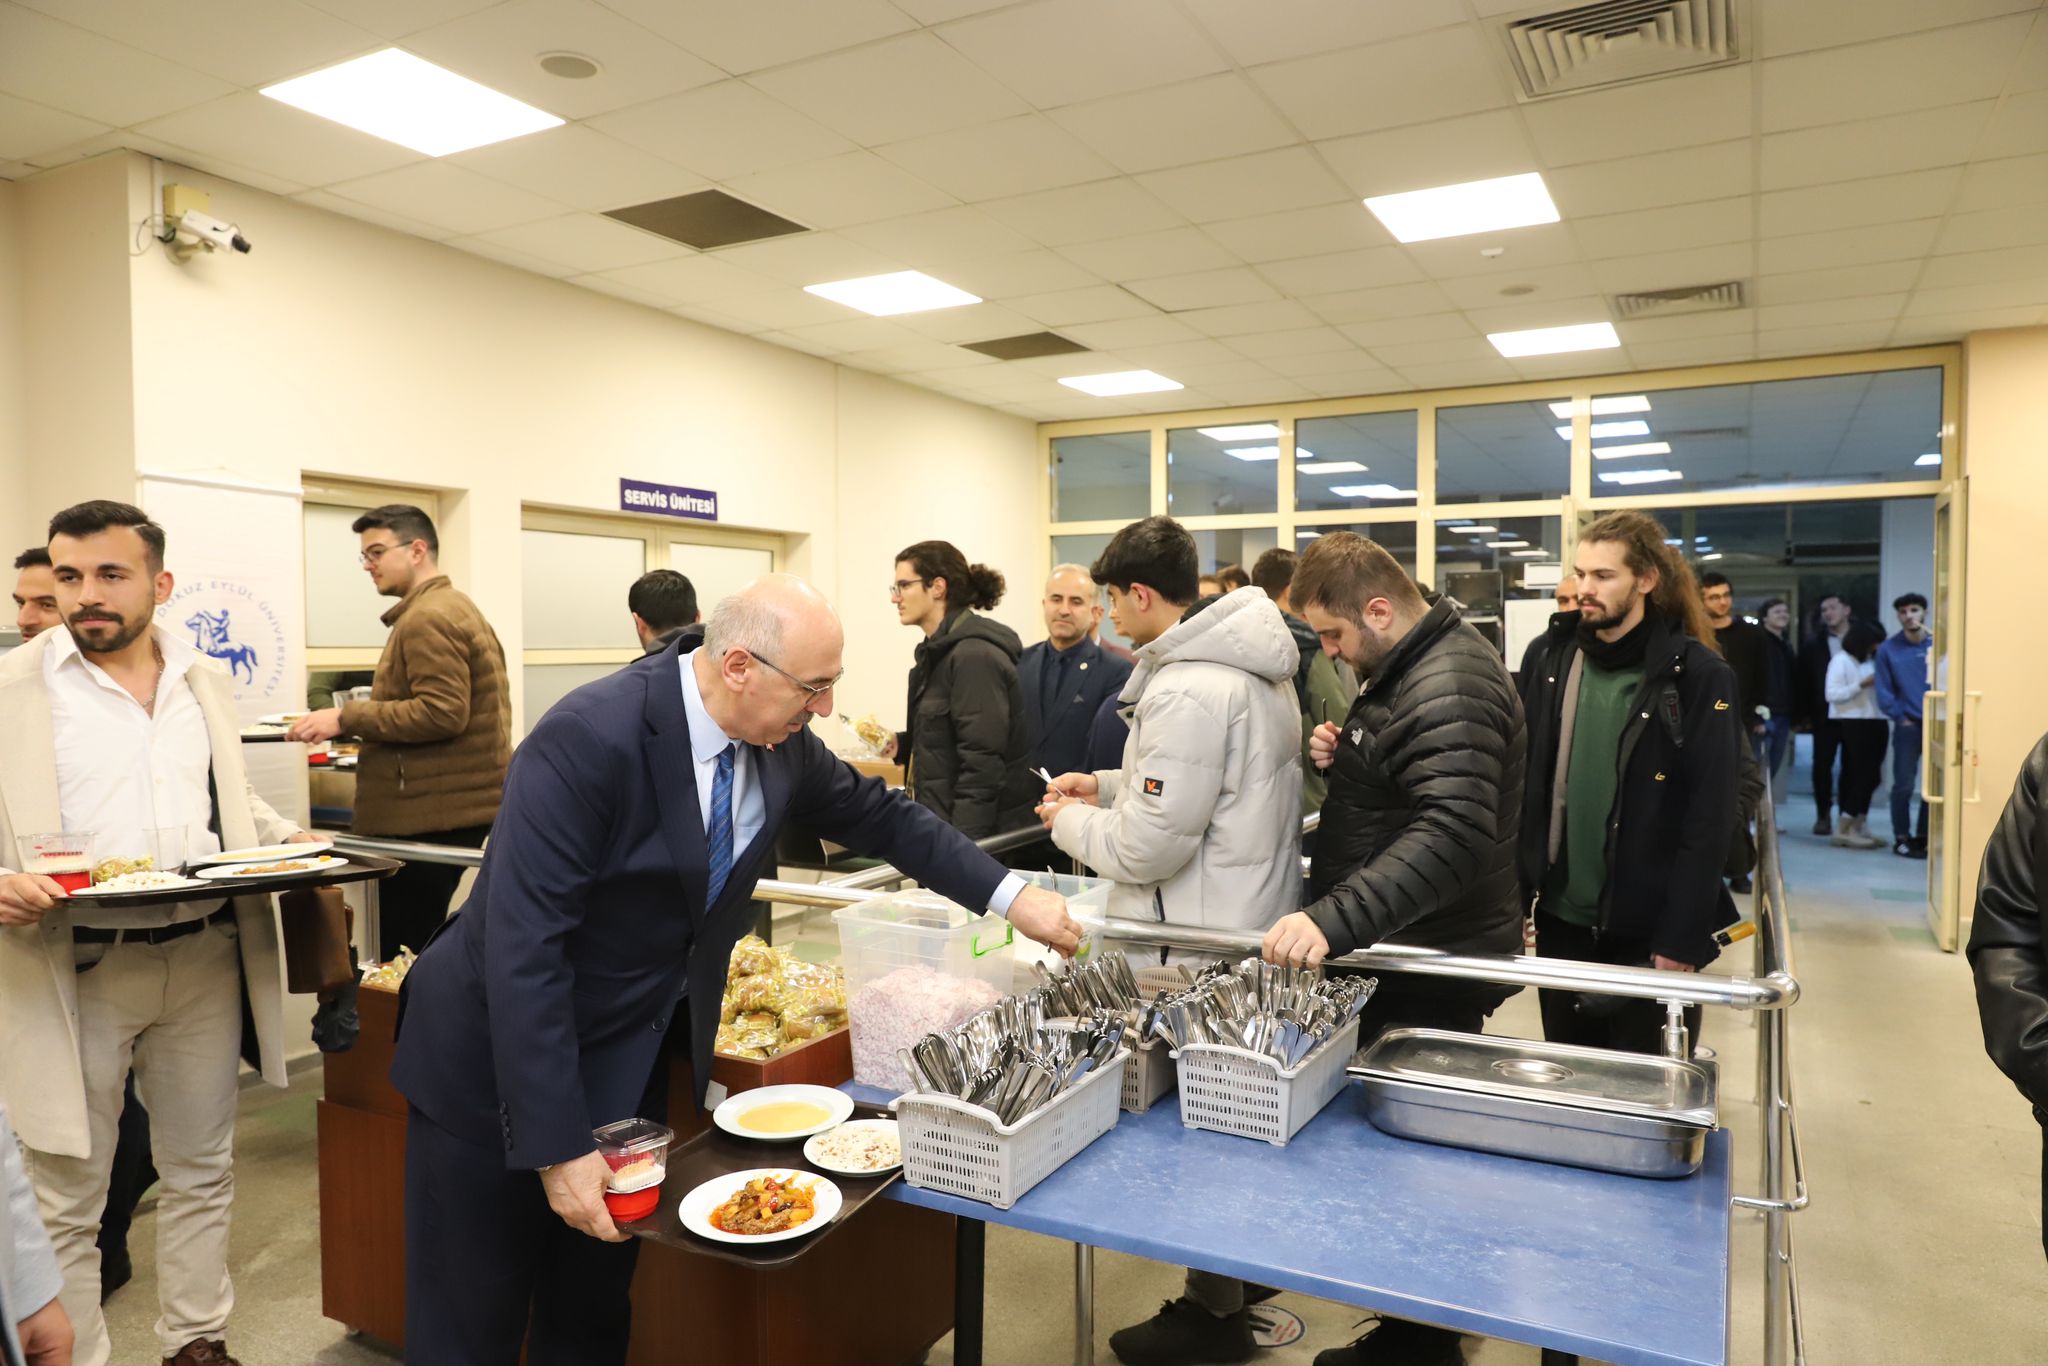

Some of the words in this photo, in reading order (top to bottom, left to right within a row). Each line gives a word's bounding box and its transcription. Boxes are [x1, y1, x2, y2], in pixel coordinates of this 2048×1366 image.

[624, 489, 667, 508] SERVİS
[669, 493, 715, 514] ÜNİTESİ
[157, 583, 203, 617] DOKUZ
